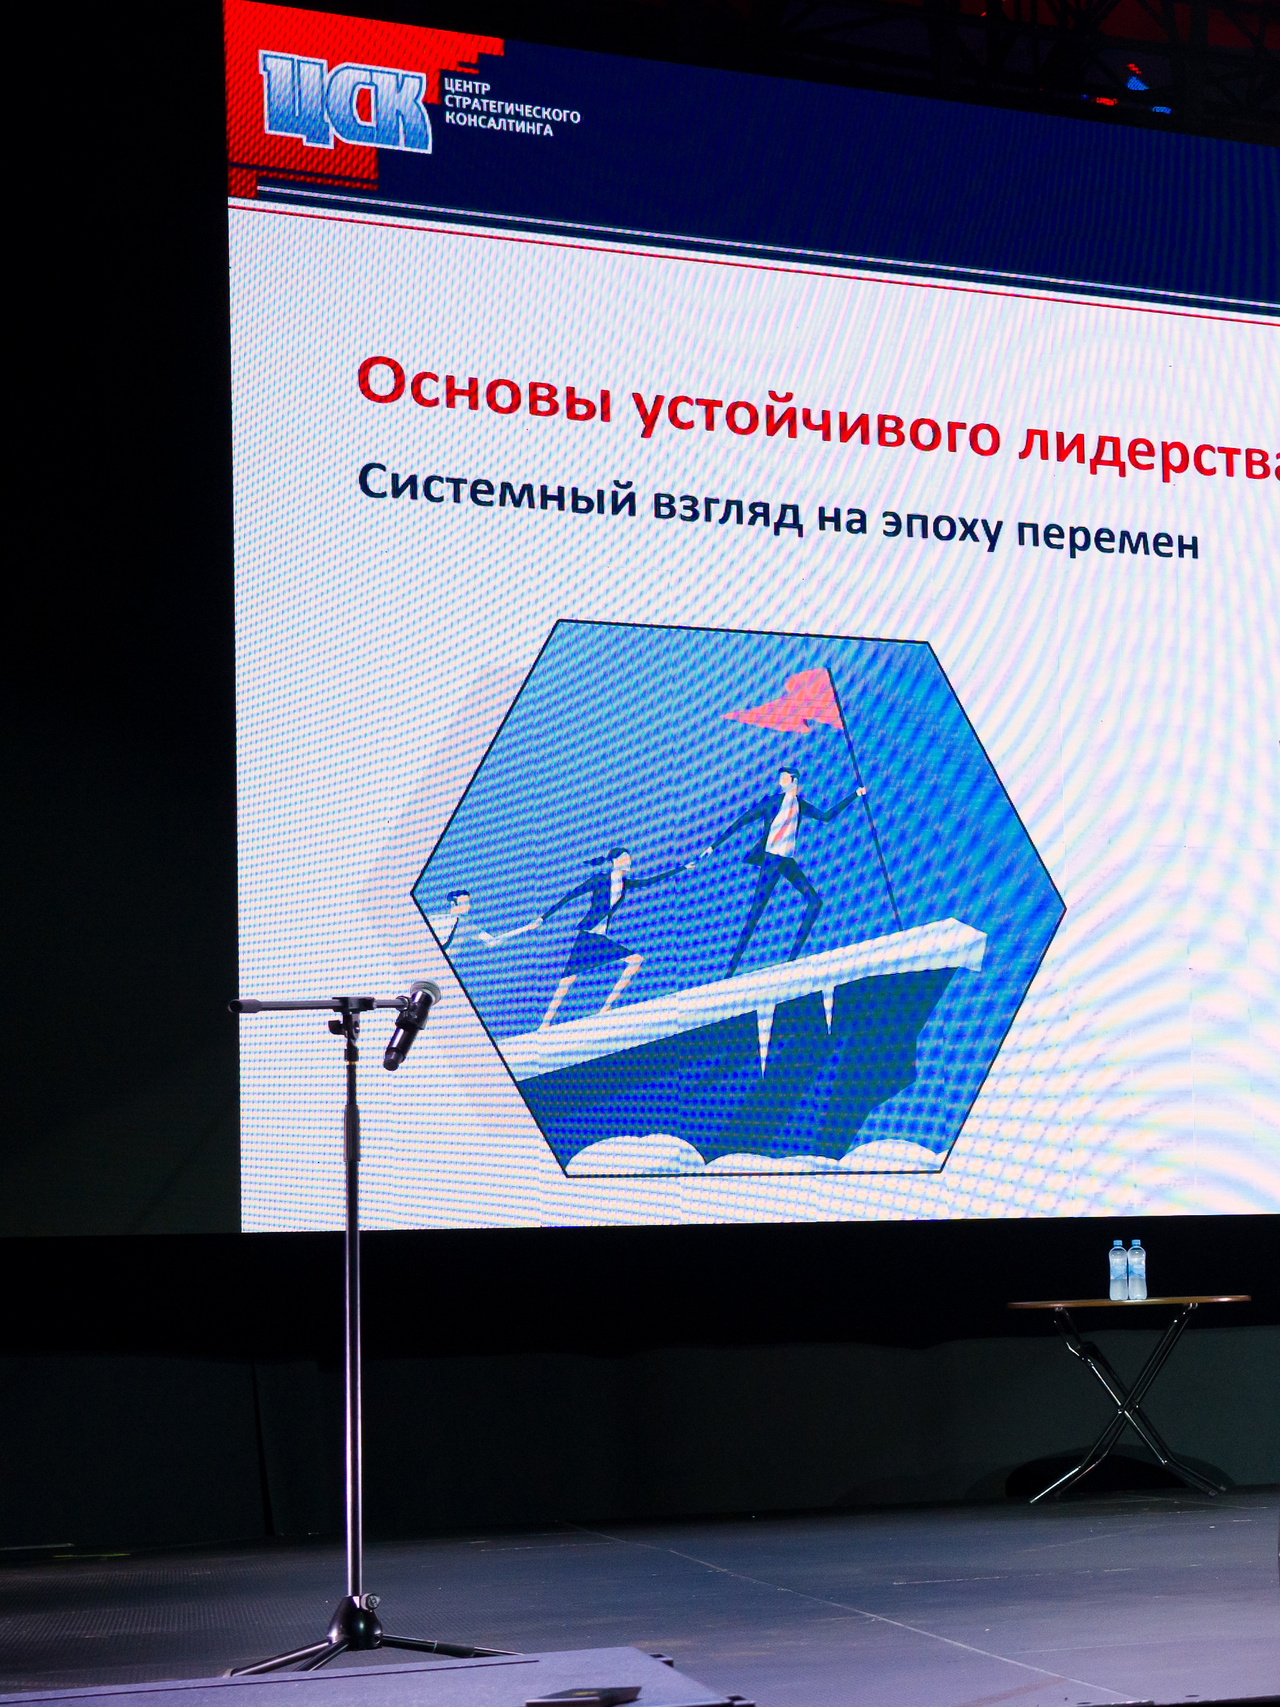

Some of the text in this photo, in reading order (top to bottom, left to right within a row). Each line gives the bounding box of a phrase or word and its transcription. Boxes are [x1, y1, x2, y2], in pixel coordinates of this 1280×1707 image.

[259, 50, 432, 154] ЦСК
[444, 77, 491, 95] ЦЕНТР
[444, 95, 581, 124] СТРАТЕГИЧЕСКОГО
[445, 111, 554, 137] КОНСАЛТИНГА
[357, 355, 611, 422] Основы
[632, 390, 1001, 457] устойчивого
[358, 462, 1200, 560] Системный взгляд на эпоху перемен
